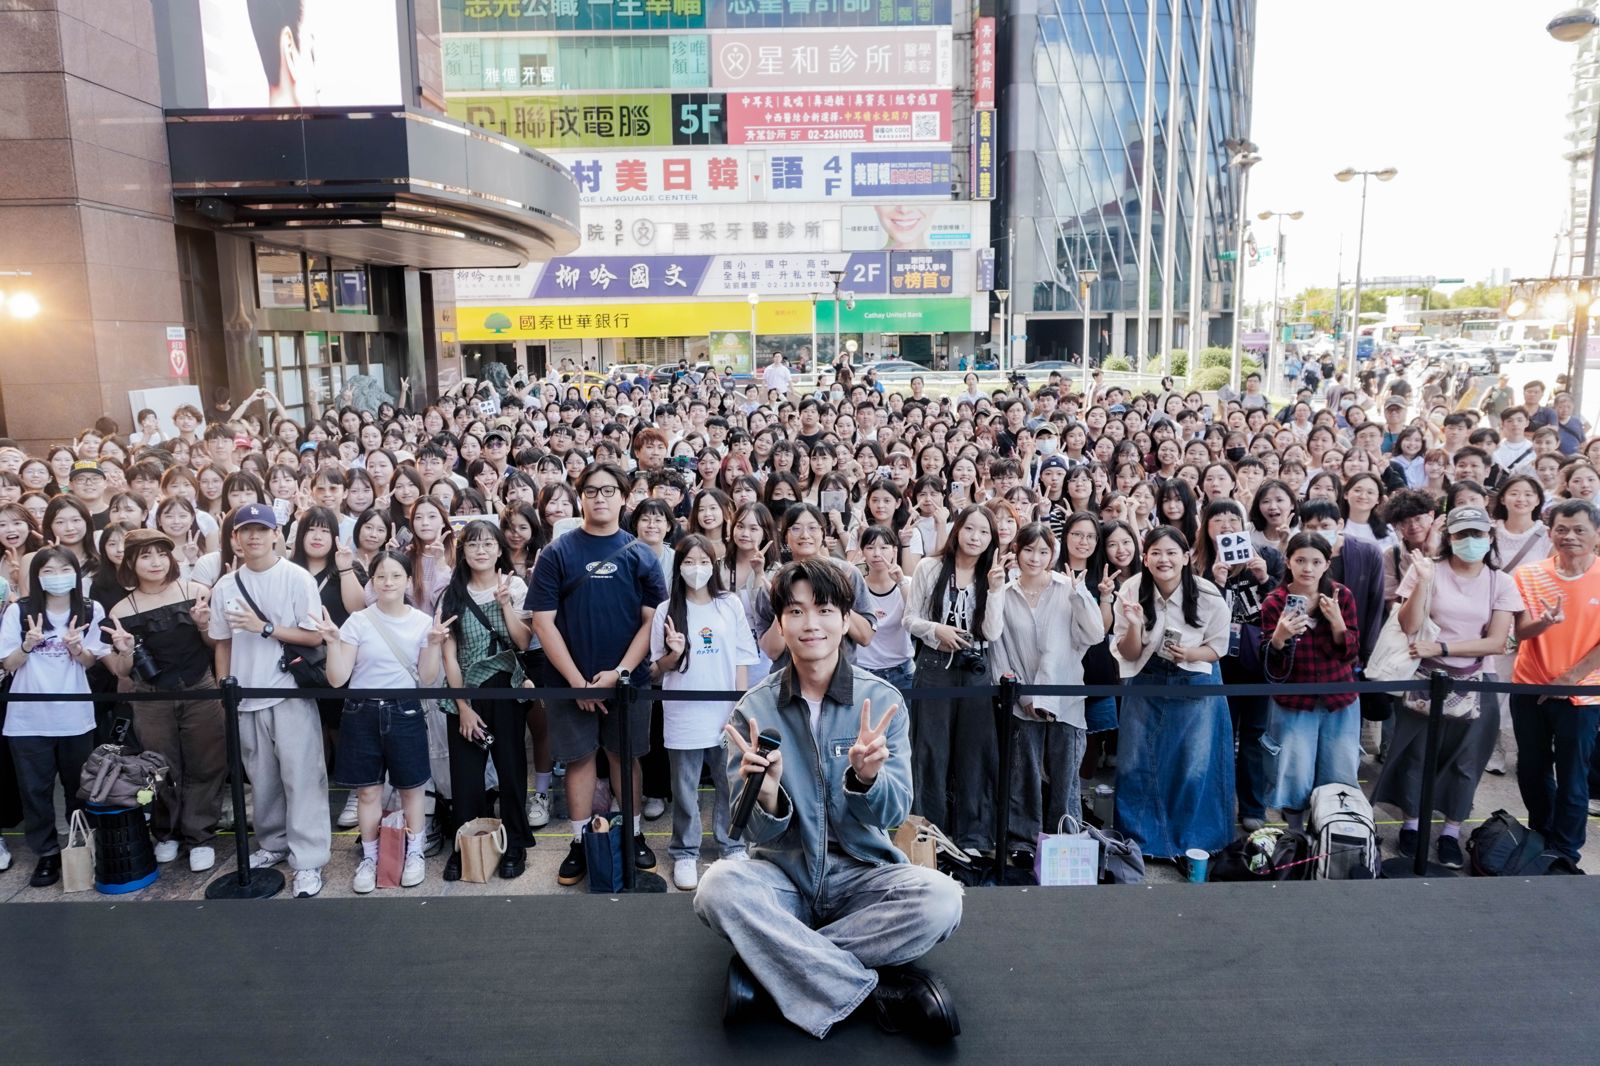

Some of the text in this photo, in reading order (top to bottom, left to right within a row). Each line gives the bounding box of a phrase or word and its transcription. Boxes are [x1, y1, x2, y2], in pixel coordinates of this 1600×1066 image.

[757, 44, 893, 76] 星和診所
[514, 105, 651, 138] 聯成電腦
[680, 103, 721, 135] 5F
[600, 194, 652, 202] LANGUAGE
[658, 193, 698, 201] CENTER
[587, 224, 604, 241] 院
[555, 263, 687, 289] 柳吟國文
[853, 264, 881, 282] 2F
[905, 271, 938, 289] 榜首
[520, 314, 629, 331] 國泰世華銀行
